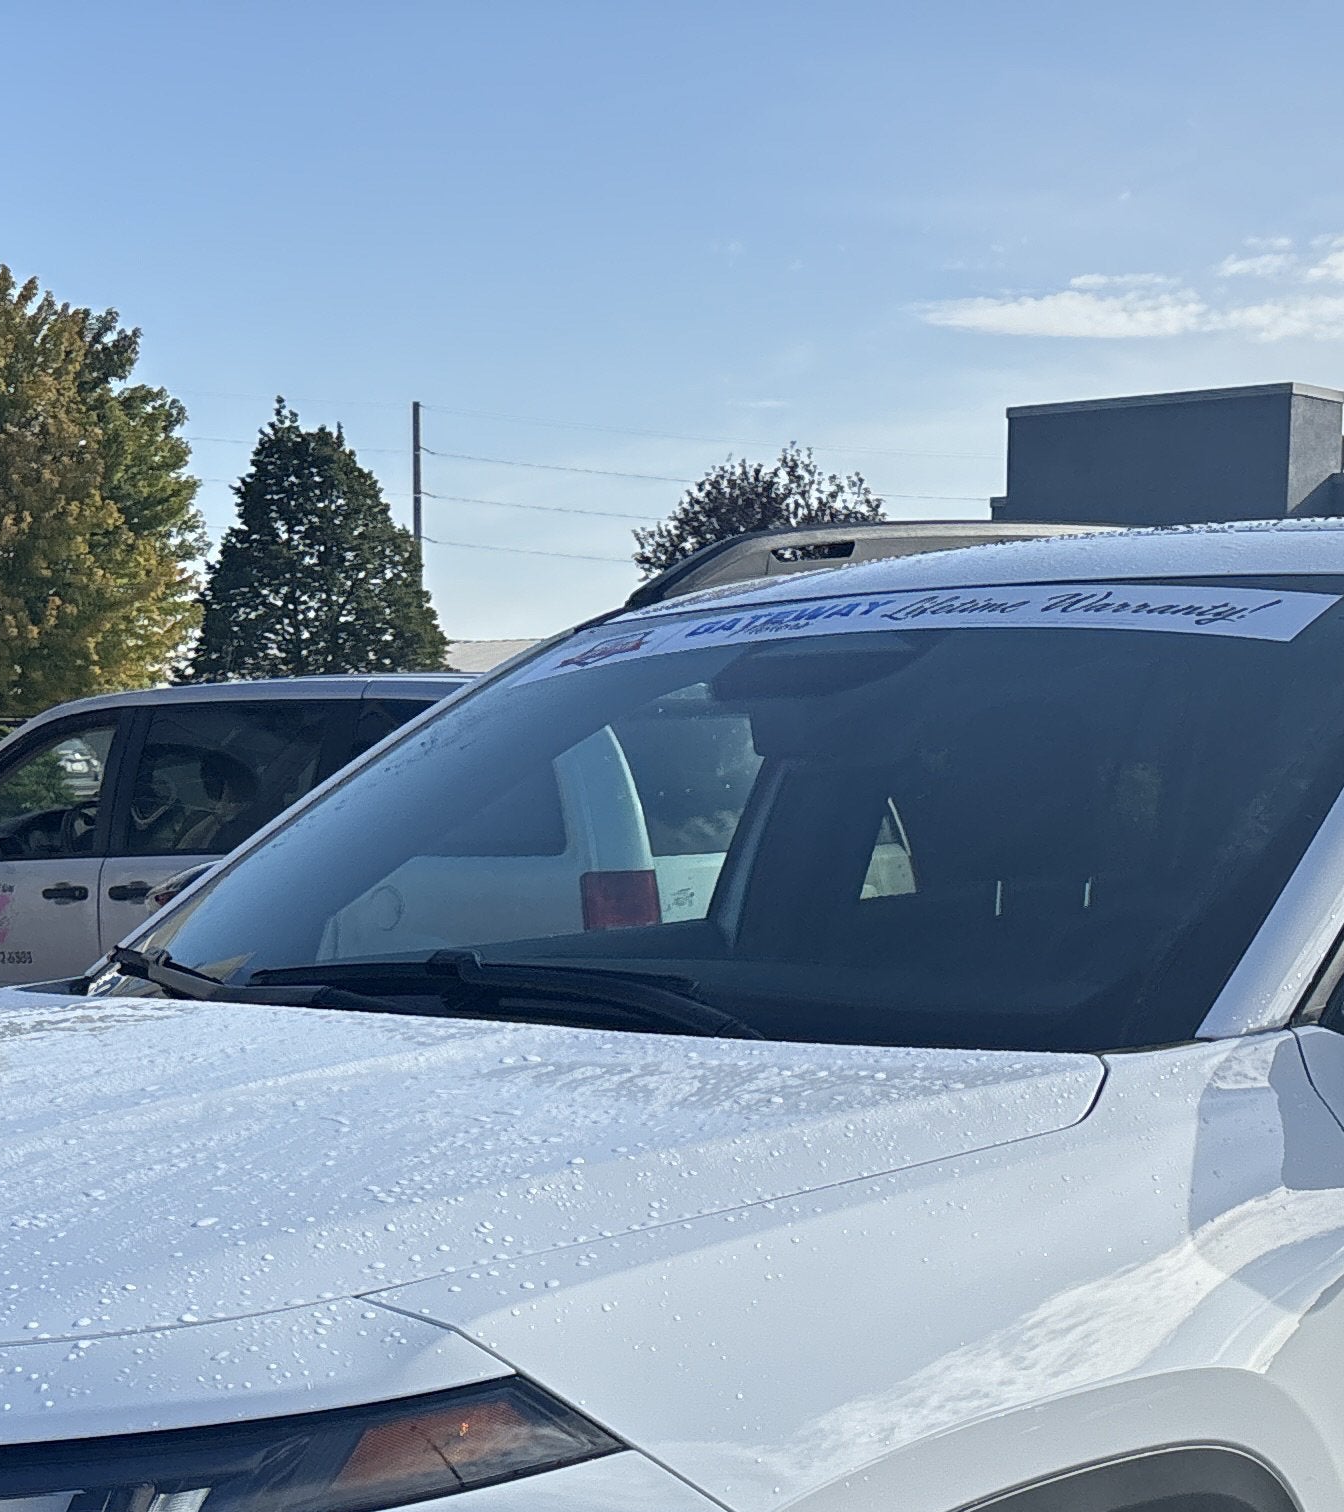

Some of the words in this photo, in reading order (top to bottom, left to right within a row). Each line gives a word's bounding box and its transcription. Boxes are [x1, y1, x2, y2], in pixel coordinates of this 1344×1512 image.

[685, 599, 892, 639] GATEWAY
[880, 595, 1032, 621] Lifetime
[1040, 591, 1283, 626] Warranty!
